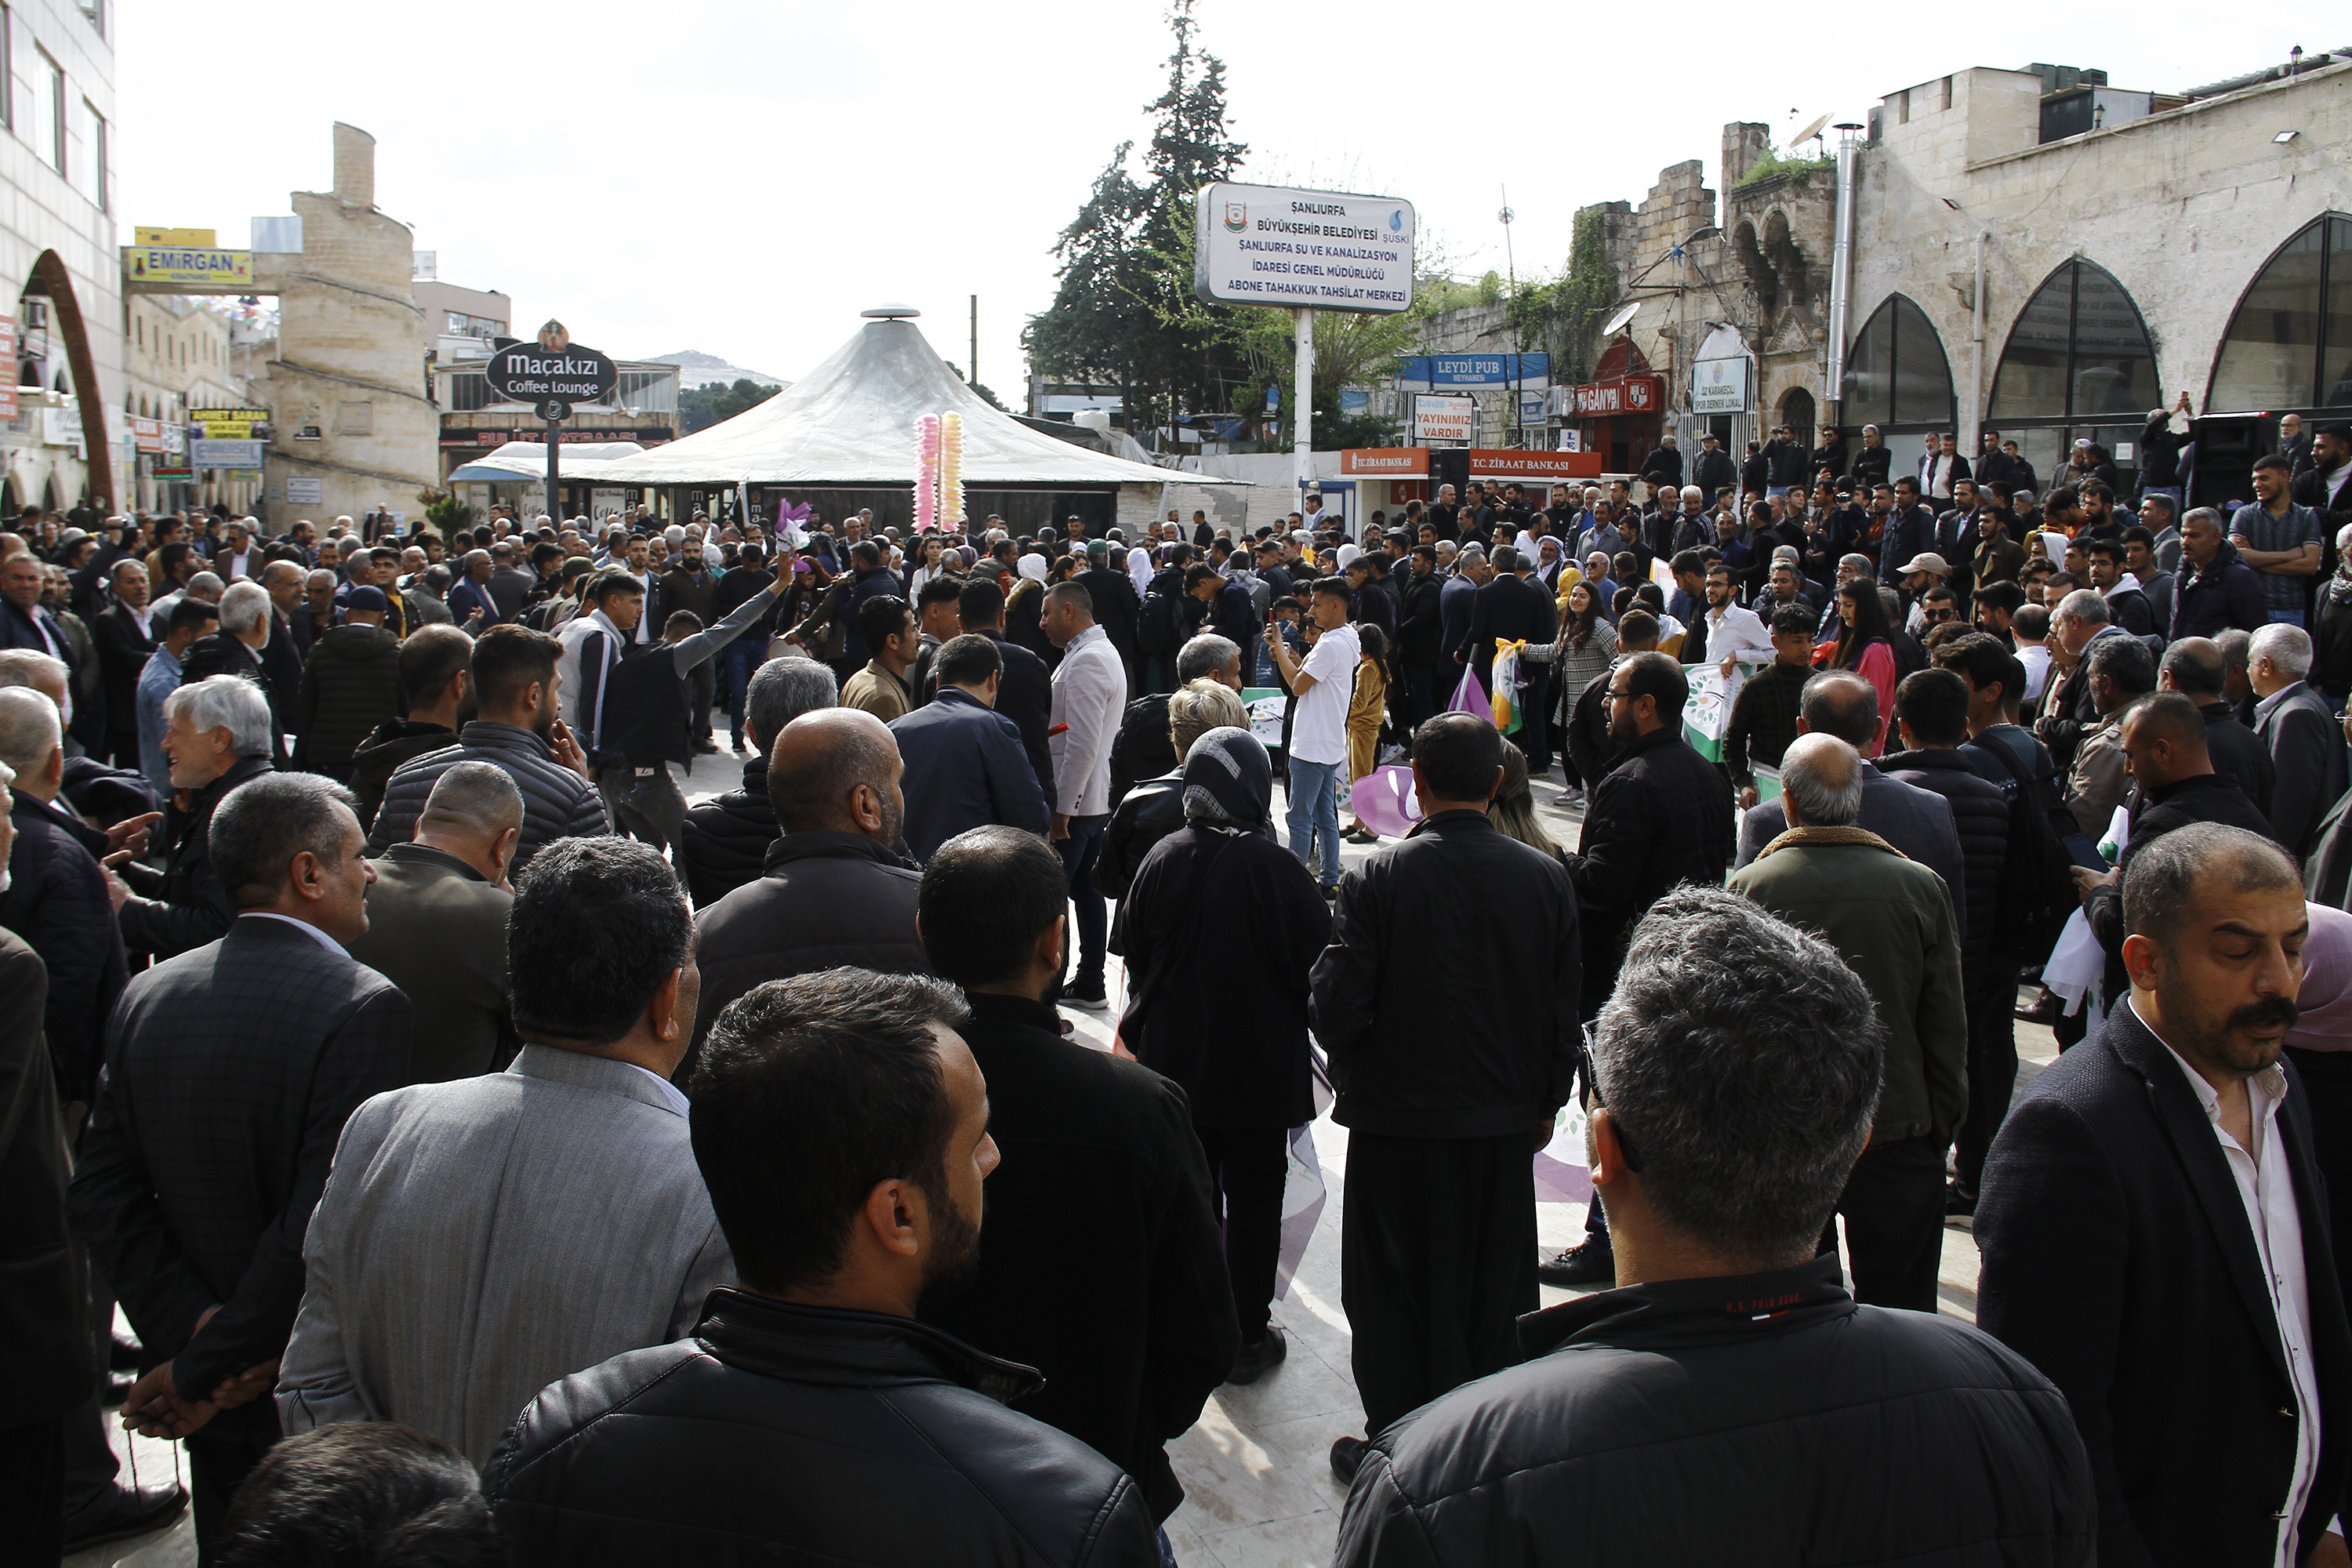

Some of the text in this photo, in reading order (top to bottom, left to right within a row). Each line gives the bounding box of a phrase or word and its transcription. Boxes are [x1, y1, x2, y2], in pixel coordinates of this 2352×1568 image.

[1291, 201, 1345, 216] ŞANLIURFA
[1258, 218, 1378, 241] BÜYÜKŞEHİR BELEDİYESİ
[1382, 234, 1410, 245] ŞUSKİ
[1239, 239, 1398, 262] ŞANLIURFA SU VE KANALİZASYON
[1253, 258, 1385, 281] İDARESİ GENEL MÜDÜRLÜĞÜ
[1228, 280, 1406, 302] ABONE TAHAKKUK TAHSİLAT MERKEZİ
[1438, 359, 1500, 374] LEYDİ PUB
[507, 379, 598, 396] Coffee Lounge
[1695, 399, 1706, 410] SPOR
[1416, 413, 1471, 426] YAYINIMIZ
[477, 432, 539, 445] BULUT
[1423, 427, 1463, 438] VARDIR
[1367, 456, 1386, 466] ZİRAAT
[1387, 457, 1412, 467] BANKASI
[1472, 457, 1569, 470] T.C. ZİRAAT BANKASI
[1726, 1301, 1748, 1312] U.S.
[1751, 1298, 1775, 1310] POLO
